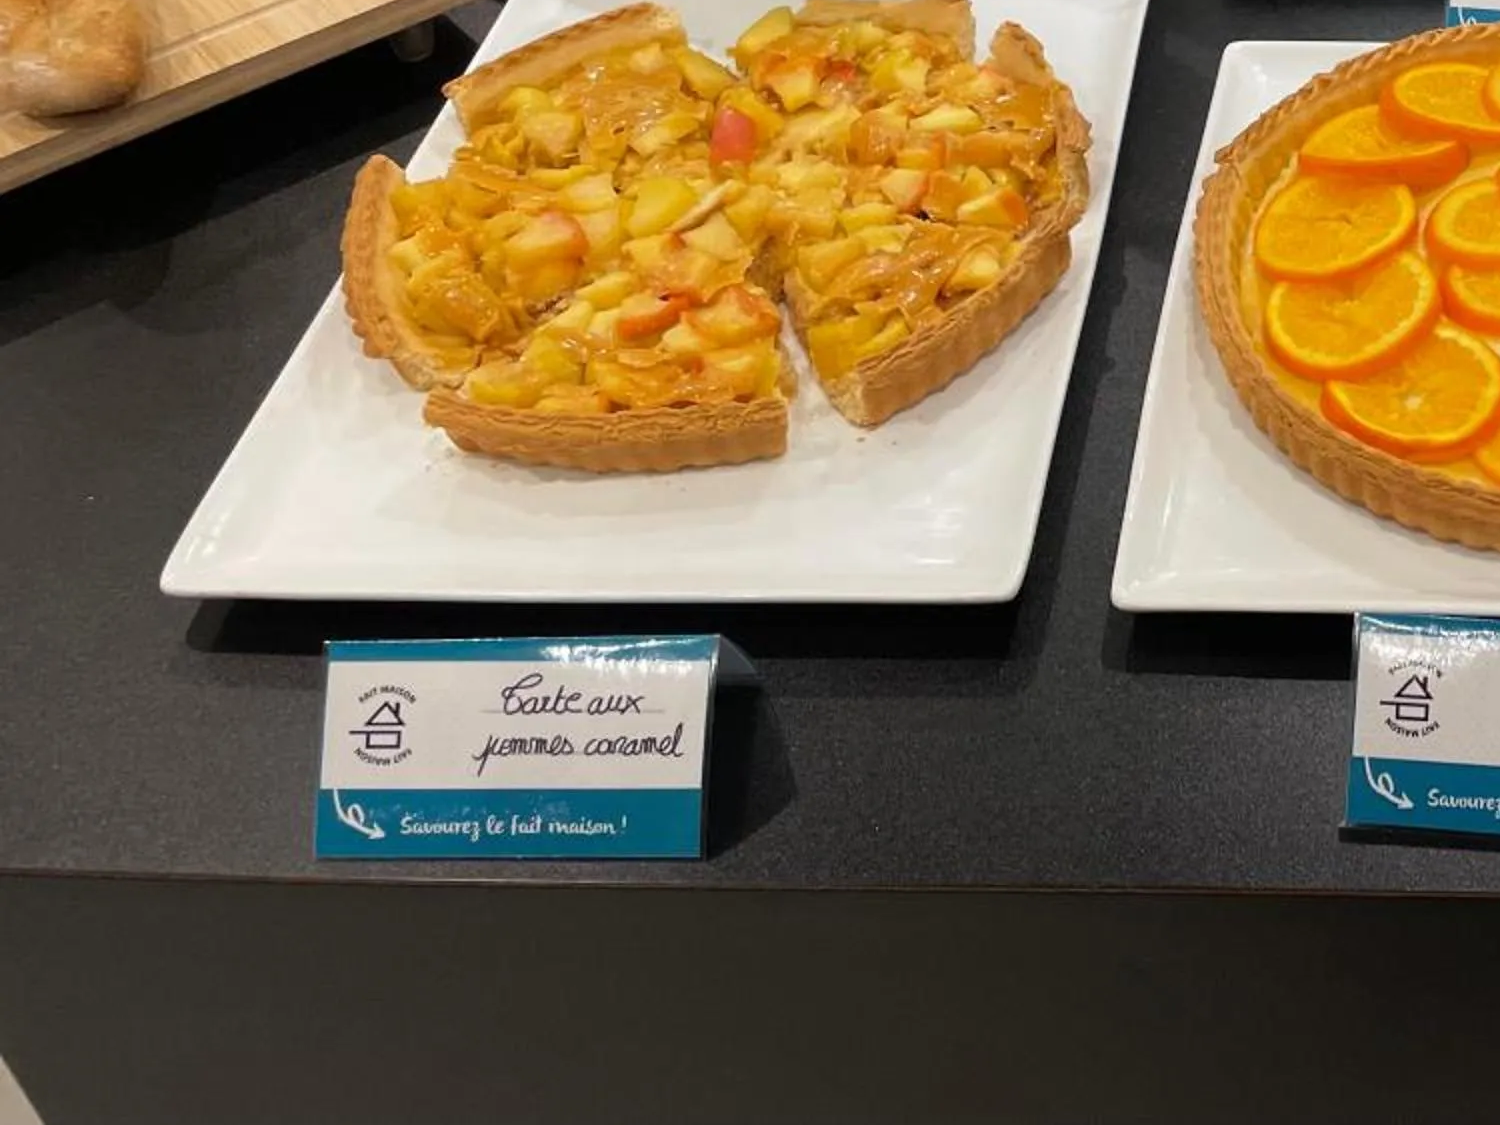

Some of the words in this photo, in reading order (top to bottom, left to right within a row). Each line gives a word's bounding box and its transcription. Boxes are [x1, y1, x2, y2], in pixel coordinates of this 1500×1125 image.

[502, 672, 583, 715] Tarte
[587, 694, 645, 716] aux
[472, 733, 575, 777] pommes
[584, 722, 684, 758] caramel
[400, 813, 480, 843] Savourez
[486, 814, 504, 835] le
[511, 814, 542, 836] fait
